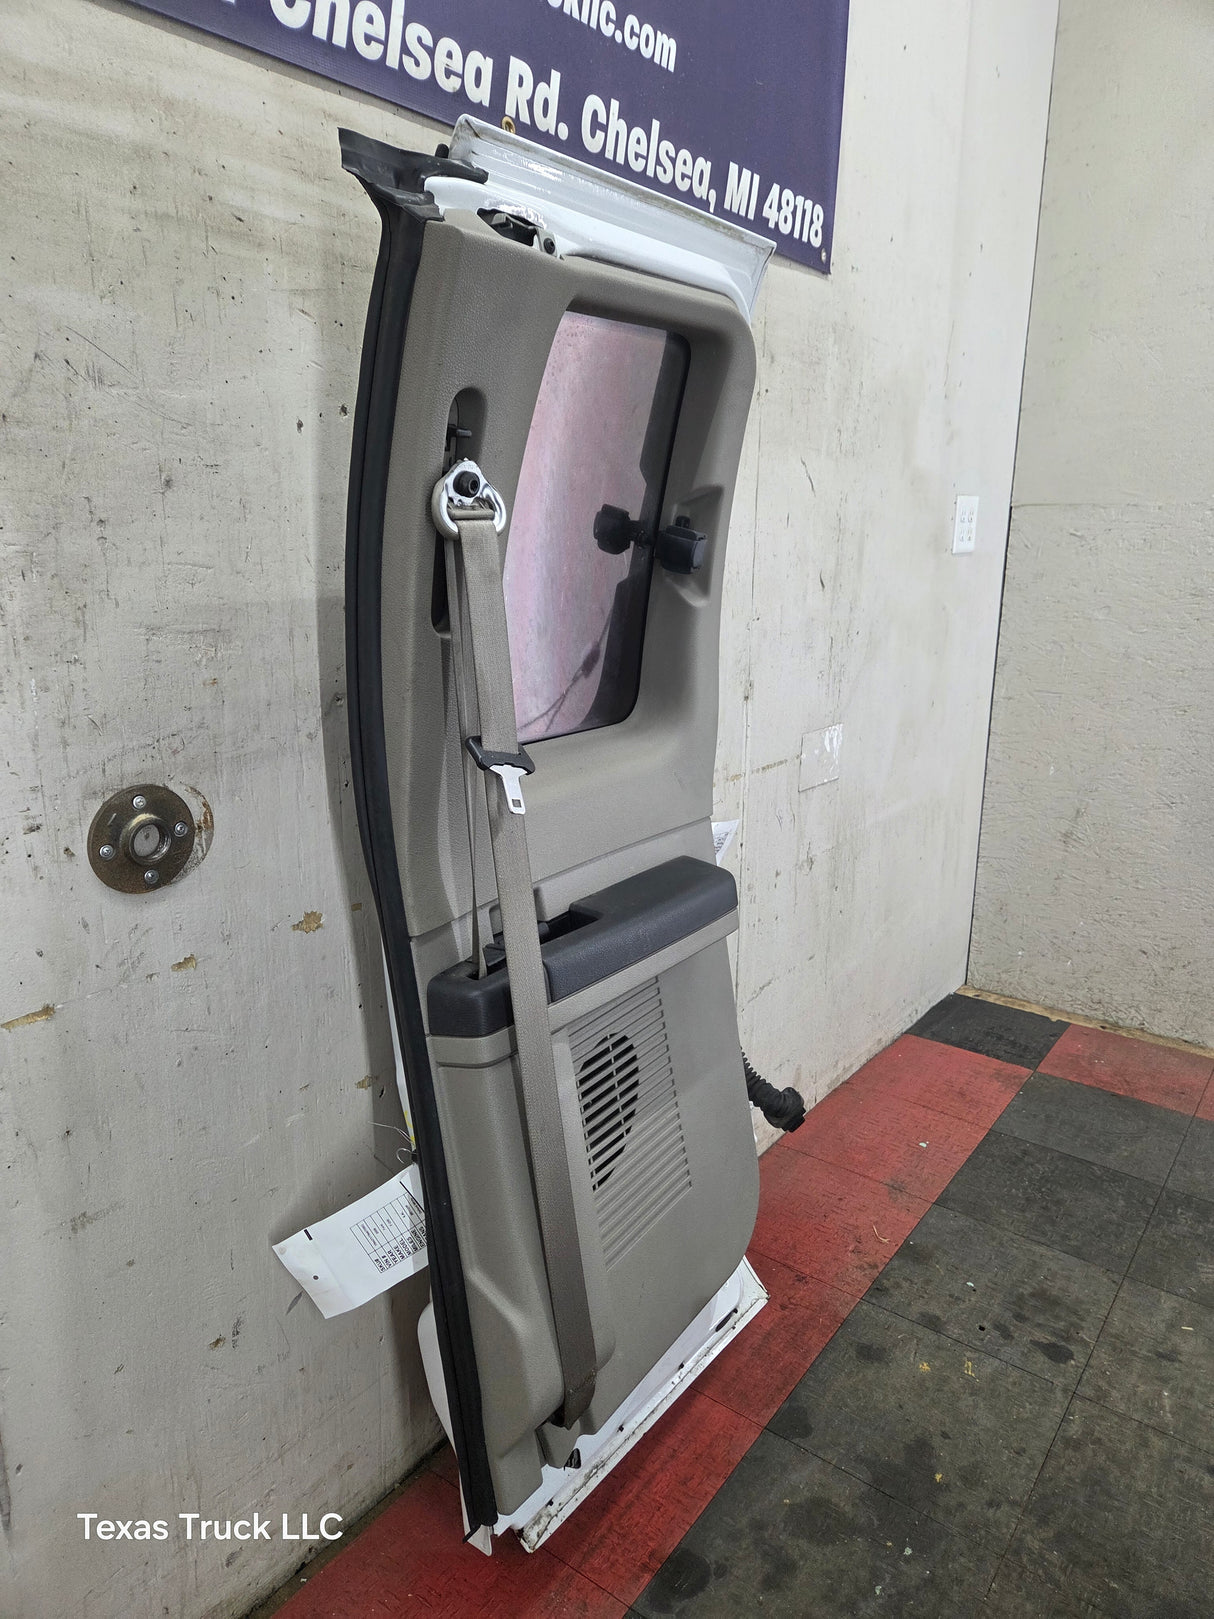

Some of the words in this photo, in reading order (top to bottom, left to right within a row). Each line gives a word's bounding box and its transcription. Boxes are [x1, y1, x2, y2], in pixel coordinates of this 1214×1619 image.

[505, 56, 569, 141] Rd.
[582, 94, 717, 214] Chelsea,
[724, 161, 761, 221] MI
[763, 183, 824, 248] 48118
[387, 1250, 398, 1264] YEAR
[394, 1245, 405, 1259] MAKE
